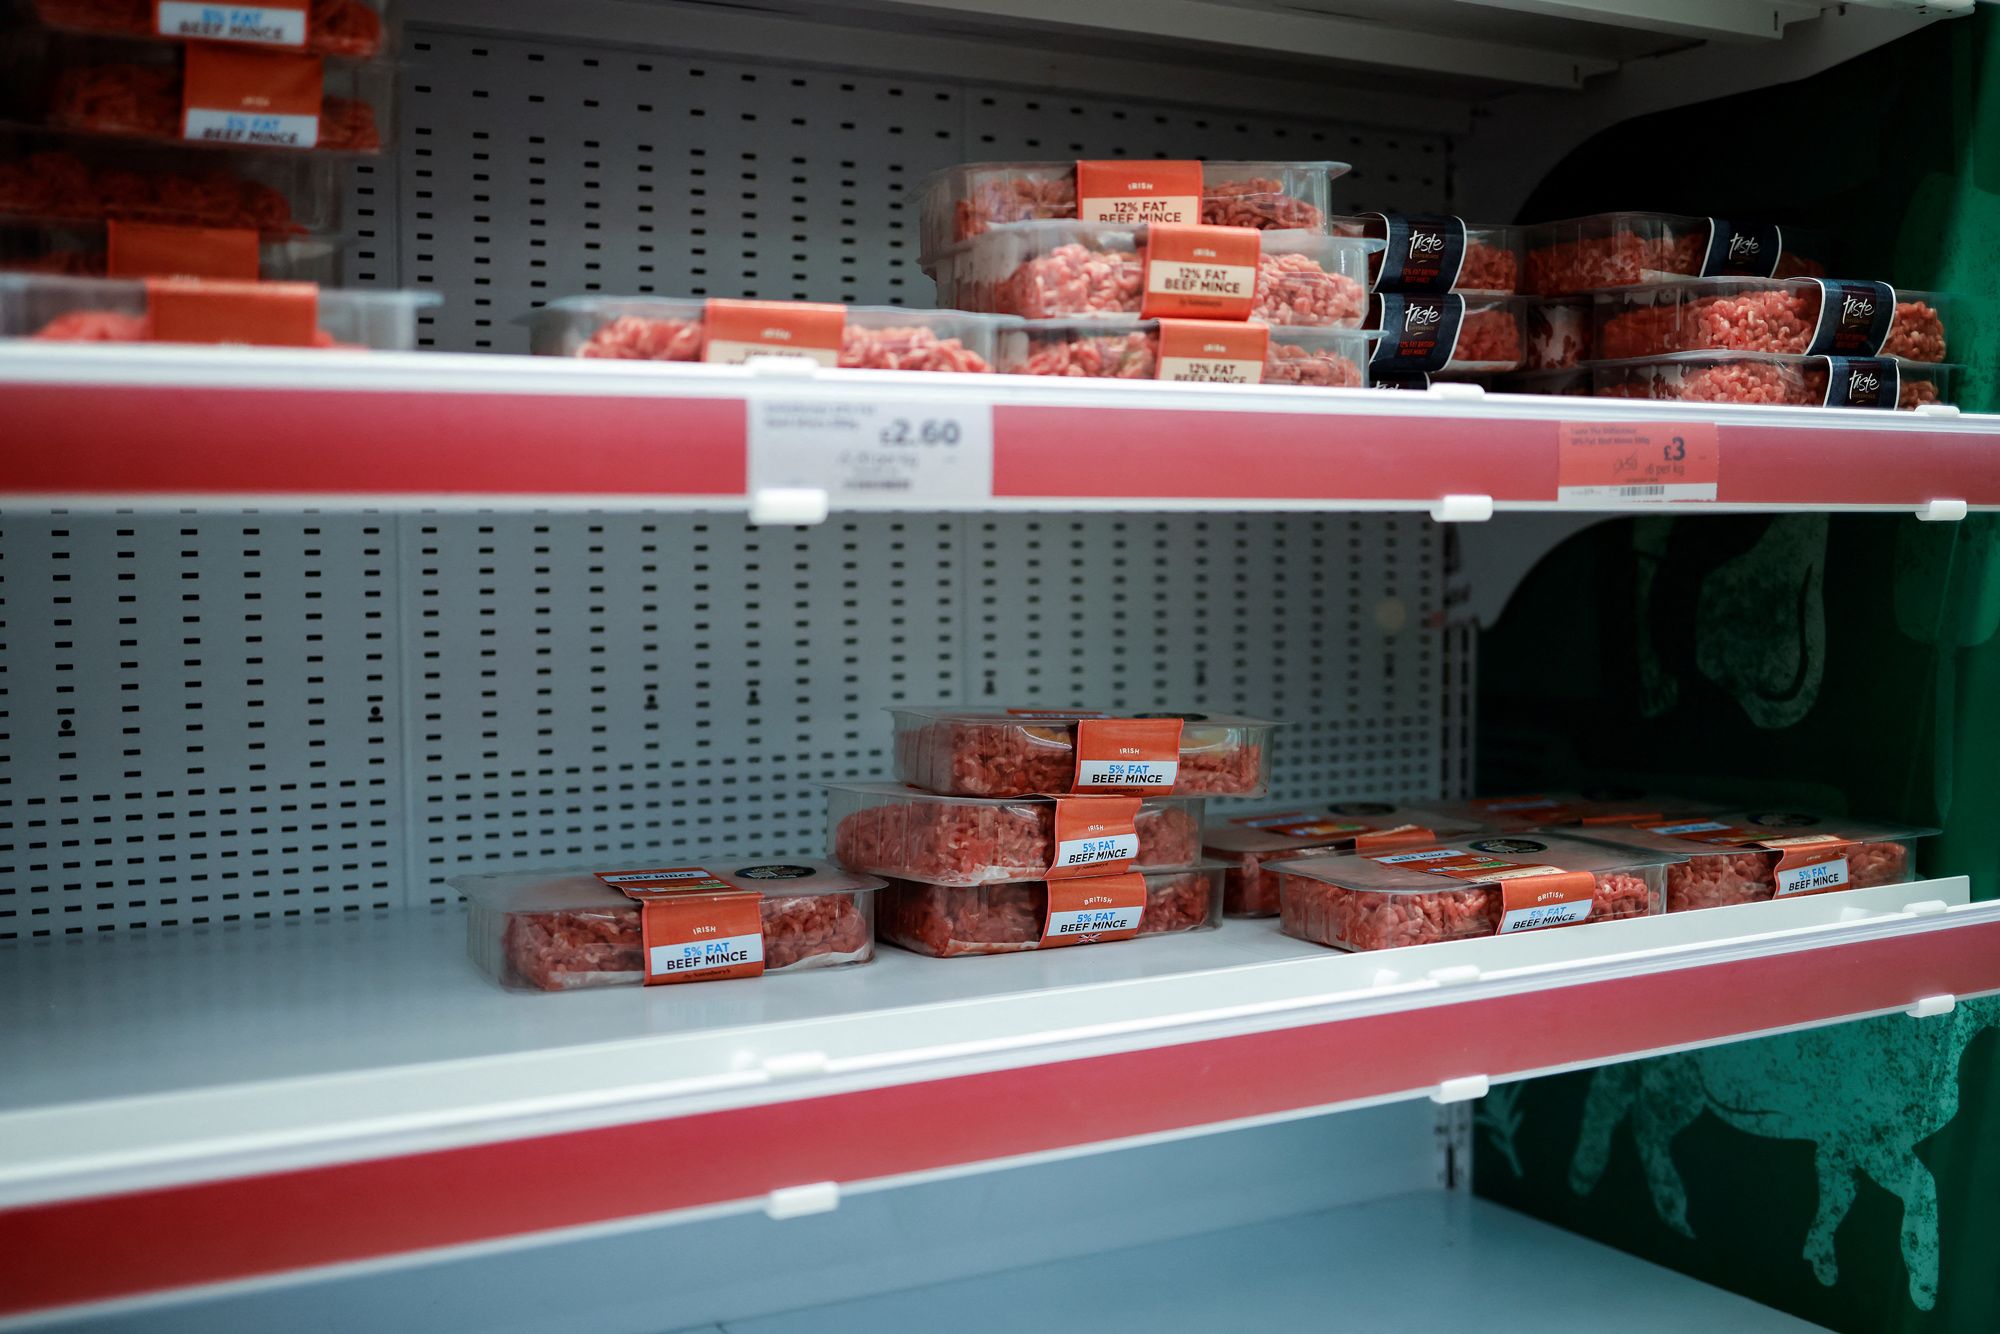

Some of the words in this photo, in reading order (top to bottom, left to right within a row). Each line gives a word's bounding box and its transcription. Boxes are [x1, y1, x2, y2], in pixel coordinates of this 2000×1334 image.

[231, 10, 263, 26] FAT
[179, 20, 224, 35] BEEF
[229, 25, 284, 40] MINCE
[252, 117, 281, 131] FAT
[202, 126, 244, 140] BEEF
[248, 131, 299, 145] MINCE
[1128, 182, 1153, 191] IRISH
[1114, 202, 1139, 213] 12%
[1142, 201, 1168, 212] FAT
[1099, 213, 1135, 224] BEEF
[1138, 212, 1182, 223] MINCE
[1409, 230, 1444, 259] taste
[1179, 268, 1201, 279] 12%
[1205, 269, 1228, 281] FAT
[1164, 278, 1198, 291] BEEF
[1200, 280, 1240, 294] MINCE
[1842, 295, 1875, 324] taste
[1405, 303, 1441, 332] taste
[1189, 363, 1209, 374] 12%
[1214, 364, 1236, 375] FAT
[1849, 370, 1880, 399] taste
[1663, 436, 1686, 461] £3
[1120, 747, 1140, 755] IRISH
[1108, 765, 1125, 775] 5%
[1128, 765, 1150, 775] FAT
[1092, 774, 1122, 784] BEEF
[1125, 774, 1163, 784] MINCE
[1082, 842, 1097, 853] 5%
[1098, 840, 1115, 851] FAT
[1068, 852, 1095, 864] BEEF
[1096, 848, 1128, 860] MINCE
[654, 872, 695, 880] MINCE
[1798, 870, 1812, 881] 5%
[1812, 866, 1827, 878] FAT
[1788, 880, 1811, 892] BEEF
[1812, 873, 1840, 887] MINCE
[1084, 896, 1113, 906] BRITISH
[1537, 891, 1565, 902] BRITISH
[1076, 913, 1092, 923] 5%
[1095, 912, 1116, 921] FAT
[1530, 908, 1545, 919] 5%
[1547, 906, 1567, 916] FAT
[1060, 922, 1090, 933] BEEF
[1092, 919, 1128, 930] MINCE
[1513, 918, 1541, 930] BEEF
[1542, 913, 1577, 925] MINCE
[692, 926, 717, 935] IRISH
[683, 946, 703, 958] 5%
[706, 942, 730, 955] FAT
[667, 957, 702, 970] BEEF
[705, 950, 748, 966] MINCE
